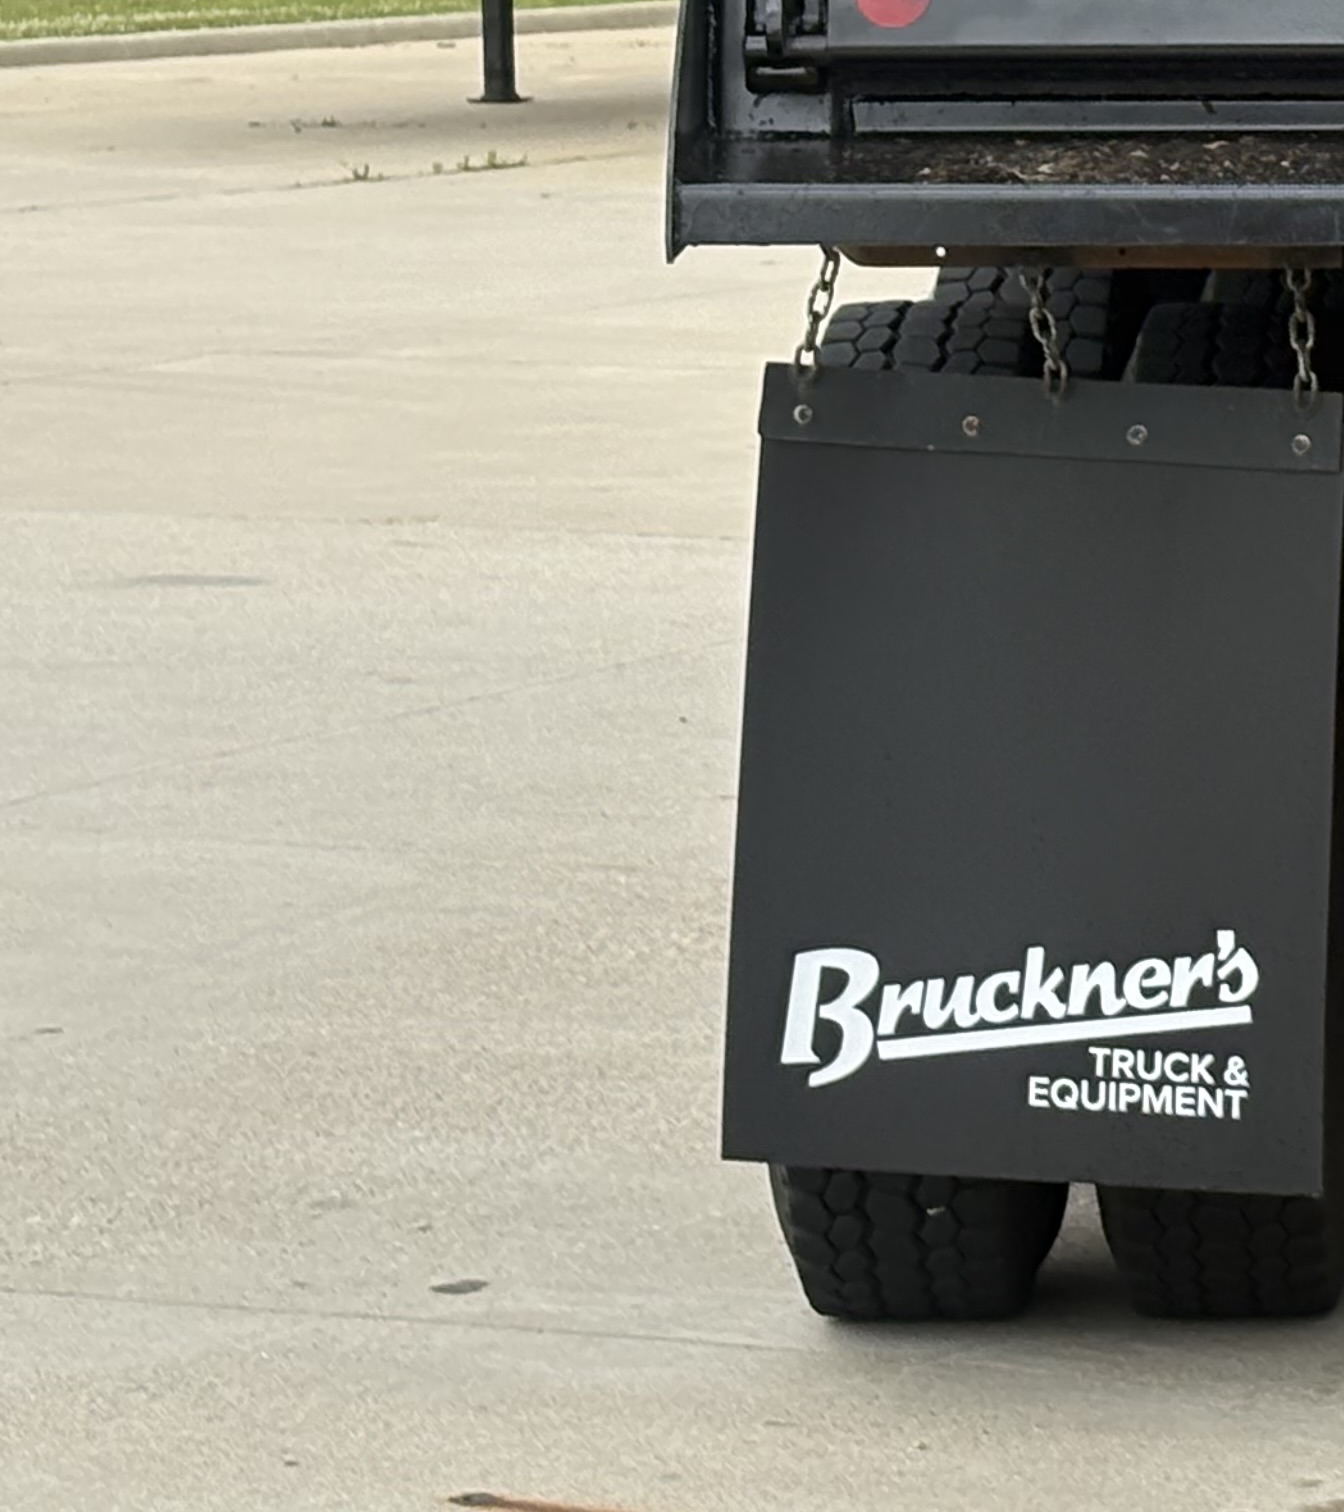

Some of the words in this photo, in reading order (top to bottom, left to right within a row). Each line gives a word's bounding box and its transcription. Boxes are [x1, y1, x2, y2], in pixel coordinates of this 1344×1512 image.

[780, 929, 1260, 1088] Bruckner's
[1088, 1046, 1215, 1085] TRUCK
[1223, 1055, 1250, 1088] &
[1027, 1075, 1249, 1120] EQUIPMENT
